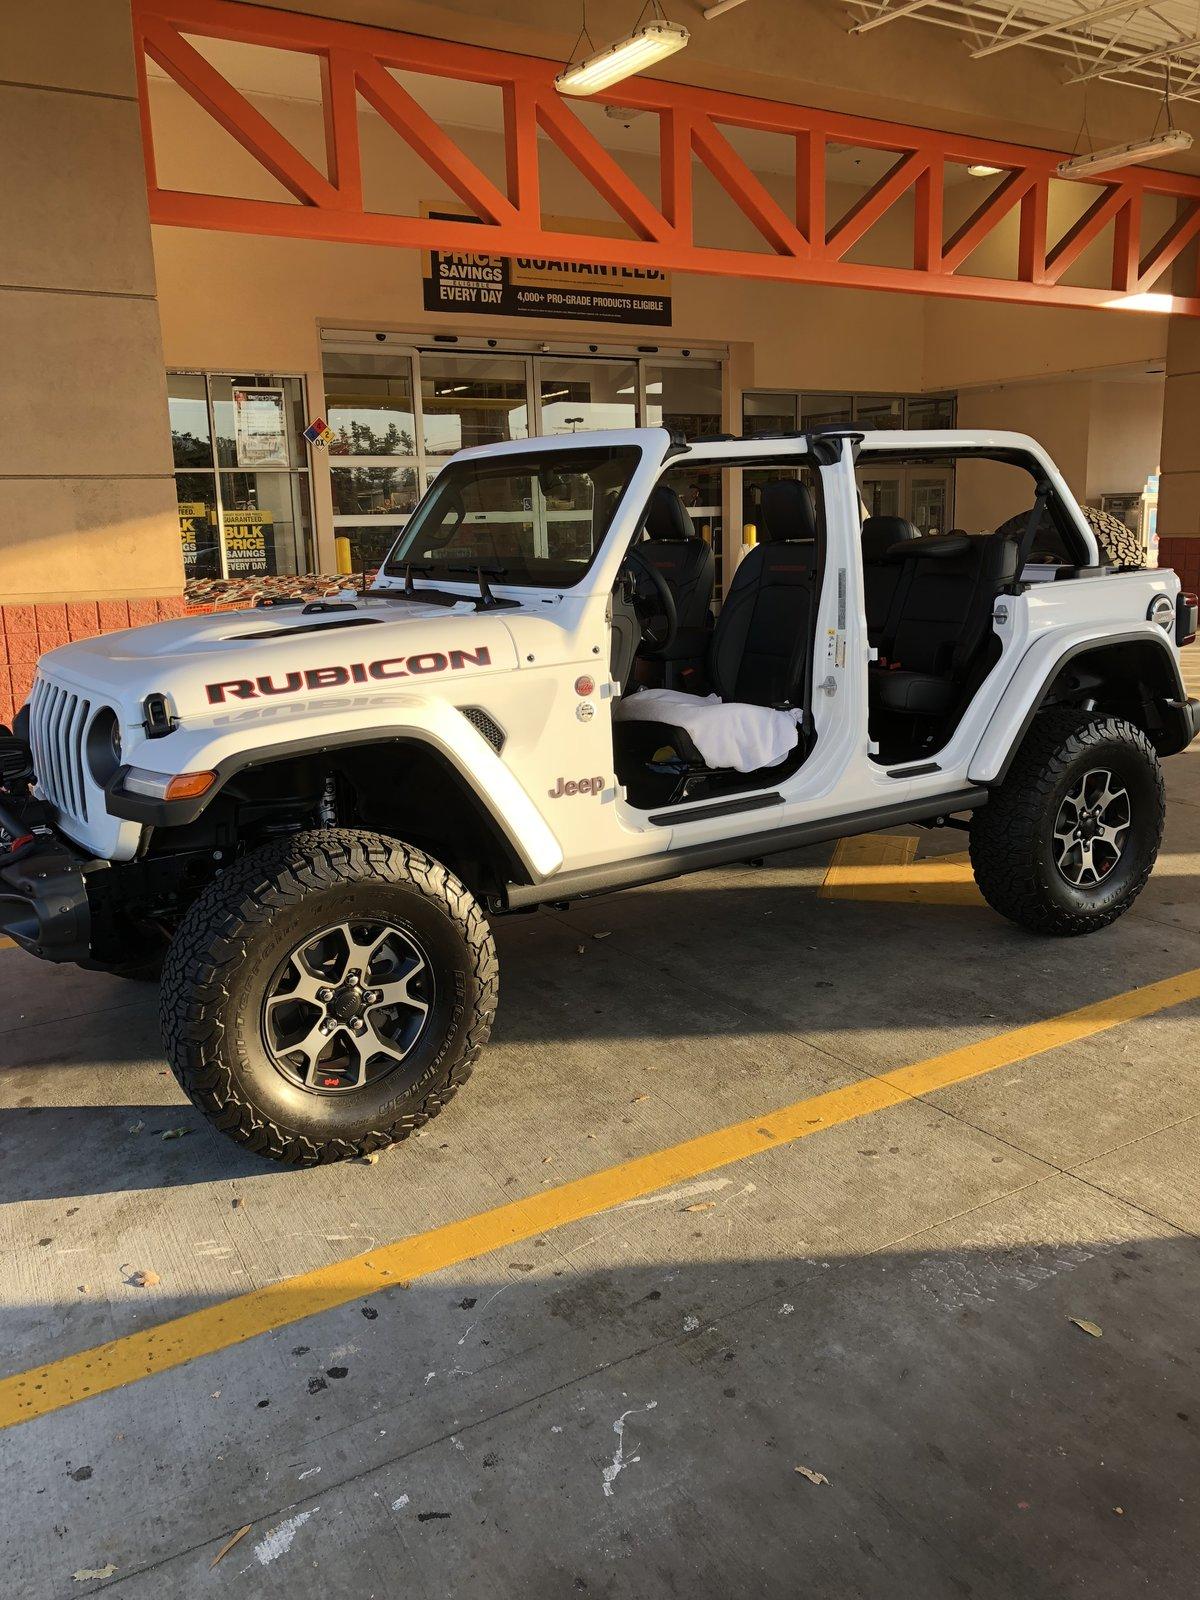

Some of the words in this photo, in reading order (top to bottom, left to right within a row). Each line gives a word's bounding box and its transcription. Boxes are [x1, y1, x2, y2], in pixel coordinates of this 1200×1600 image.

[439, 263, 503, 282] SAVINGS
[440, 286, 478, 302] EVERY
[480, 289, 503, 304] DAY
[517, 291, 545, 304] 4,000+
[546, 293, 592, 306] PRO-GRADE
[592, 297, 632, 309] PRODUCTS
[632, 300, 664, 311] ELIGIBLE
[225, 525, 264, 538] BULK
[225, 538, 265, 550] PRICE
[227, 562, 249, 570] EVERY
[205, 646, 492, 705] RUBICON
[547, 776, 606, 799] Jeep
